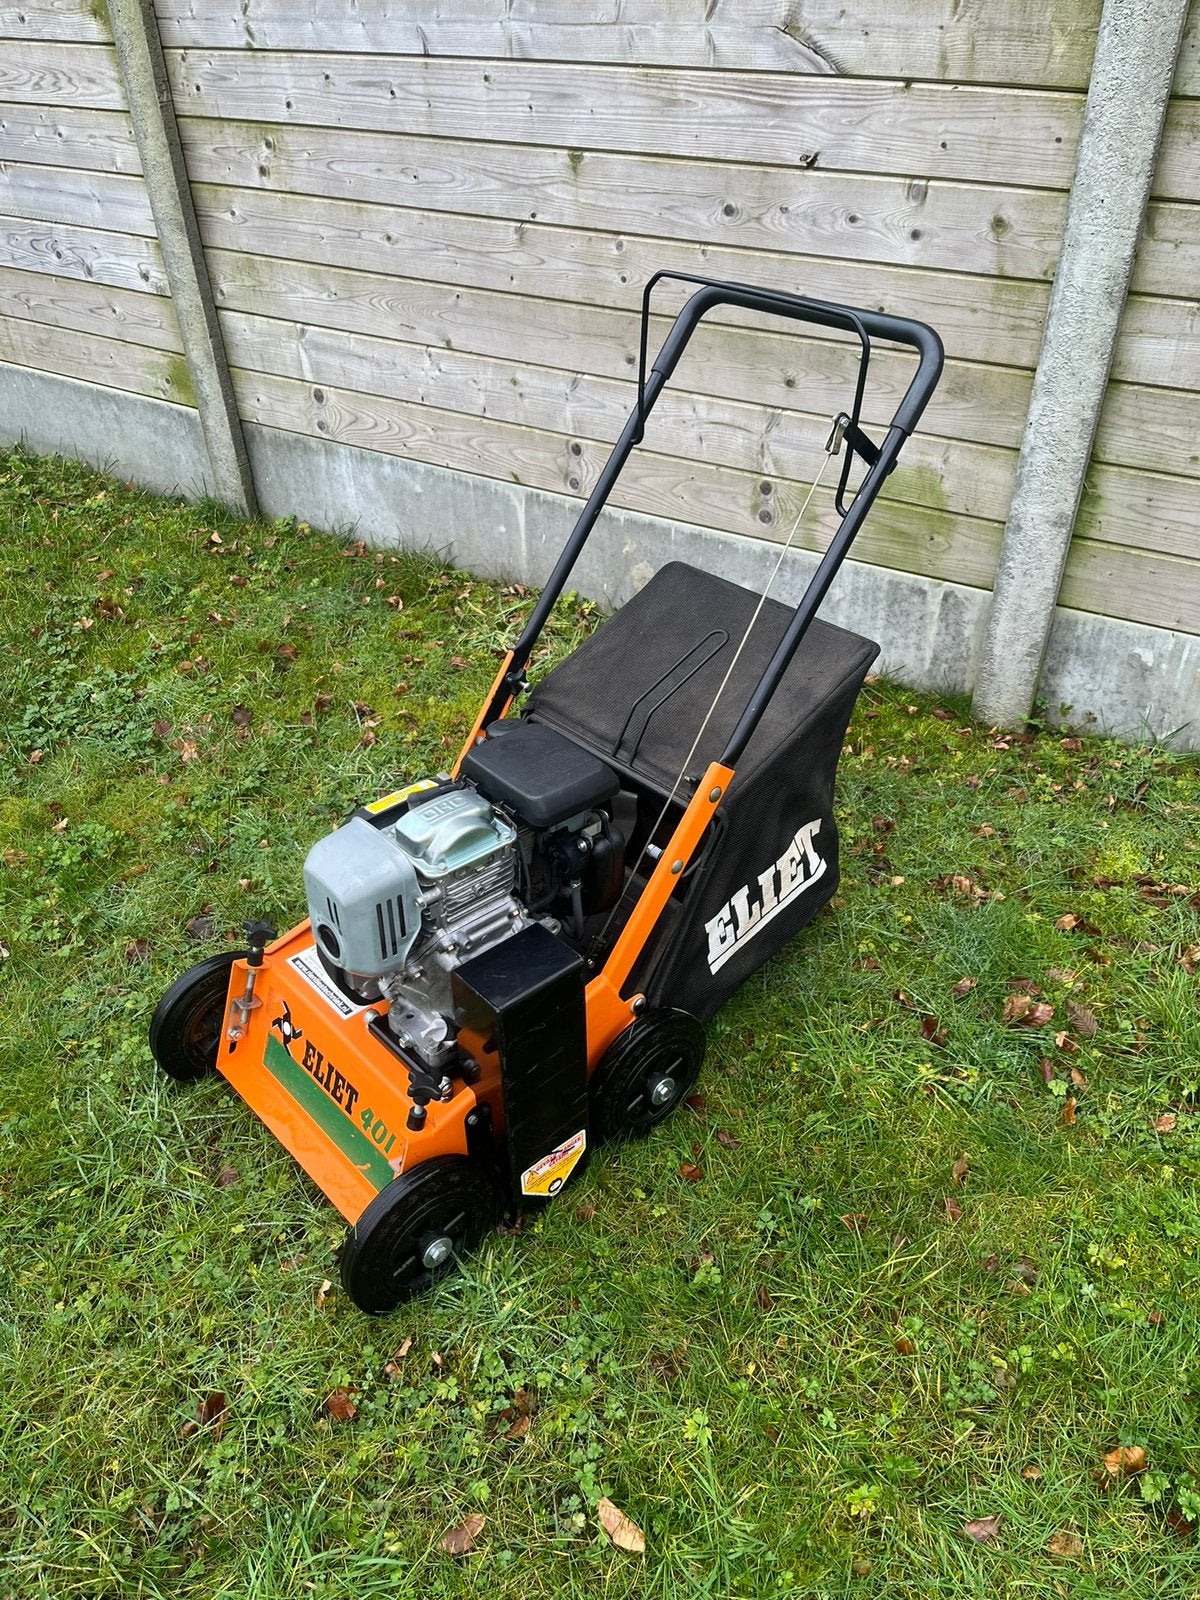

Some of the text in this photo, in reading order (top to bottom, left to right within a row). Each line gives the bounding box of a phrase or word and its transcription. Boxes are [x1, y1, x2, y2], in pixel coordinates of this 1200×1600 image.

[420, 797, 468, 820] OHC
[704, 818, 823, 966] ELIET
[301, 1039, 397, 1154] ELIET 401
